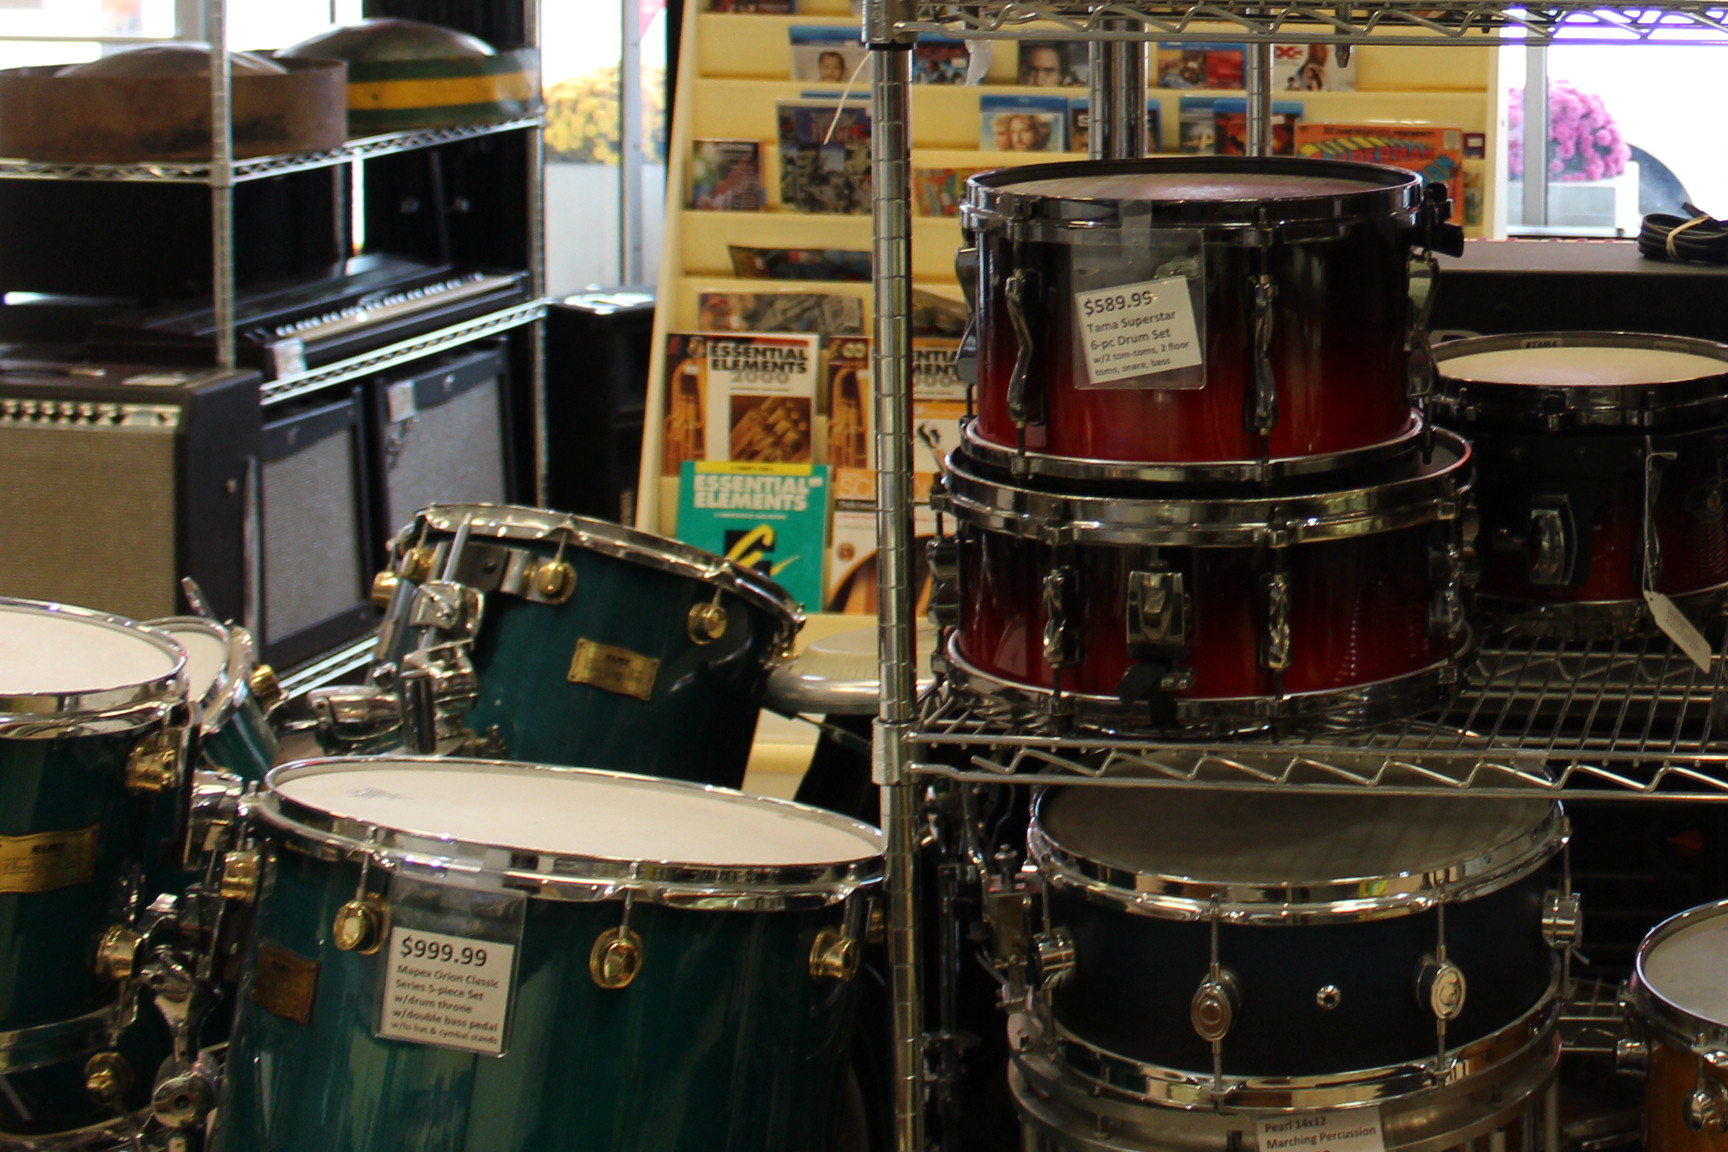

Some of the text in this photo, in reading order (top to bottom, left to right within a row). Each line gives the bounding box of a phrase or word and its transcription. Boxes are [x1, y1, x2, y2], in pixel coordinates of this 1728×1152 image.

[1084, 291, 1153, 317] $589.99
[1087, 311, 1176, 334] Tama Superstar
[1090, 329, 1171, 351] 6-pc Drum Set
[709, 346, 809, 361] ESSENTIAL
[1093, 354, 1111, 364] w/2
[1160, 344, 1167, 352] 2
[1168, 341, 1190, 351] floor
[711, 359, 806, 374] ELEMENTS
[730, 372, 790, 383] 2000
[694, 474, 810, 494] ESSENTIAL
[693, 491, 808, 512] ELEMENTS
[400, 935, 488, 967] $999.99
[397, 965, 499, 989] Mapex Orion Classic
[395, 979, 484, 1001] Series 5-piece Set
[394, 994, 473, 1014] w/drum throne
[392, 1007, 498, 1033] w/double bass pedal
[1265, 1116, 1327, 1133] Pearl 14x12
[1266, 1126, 1376, 1150] Marching Percussion
